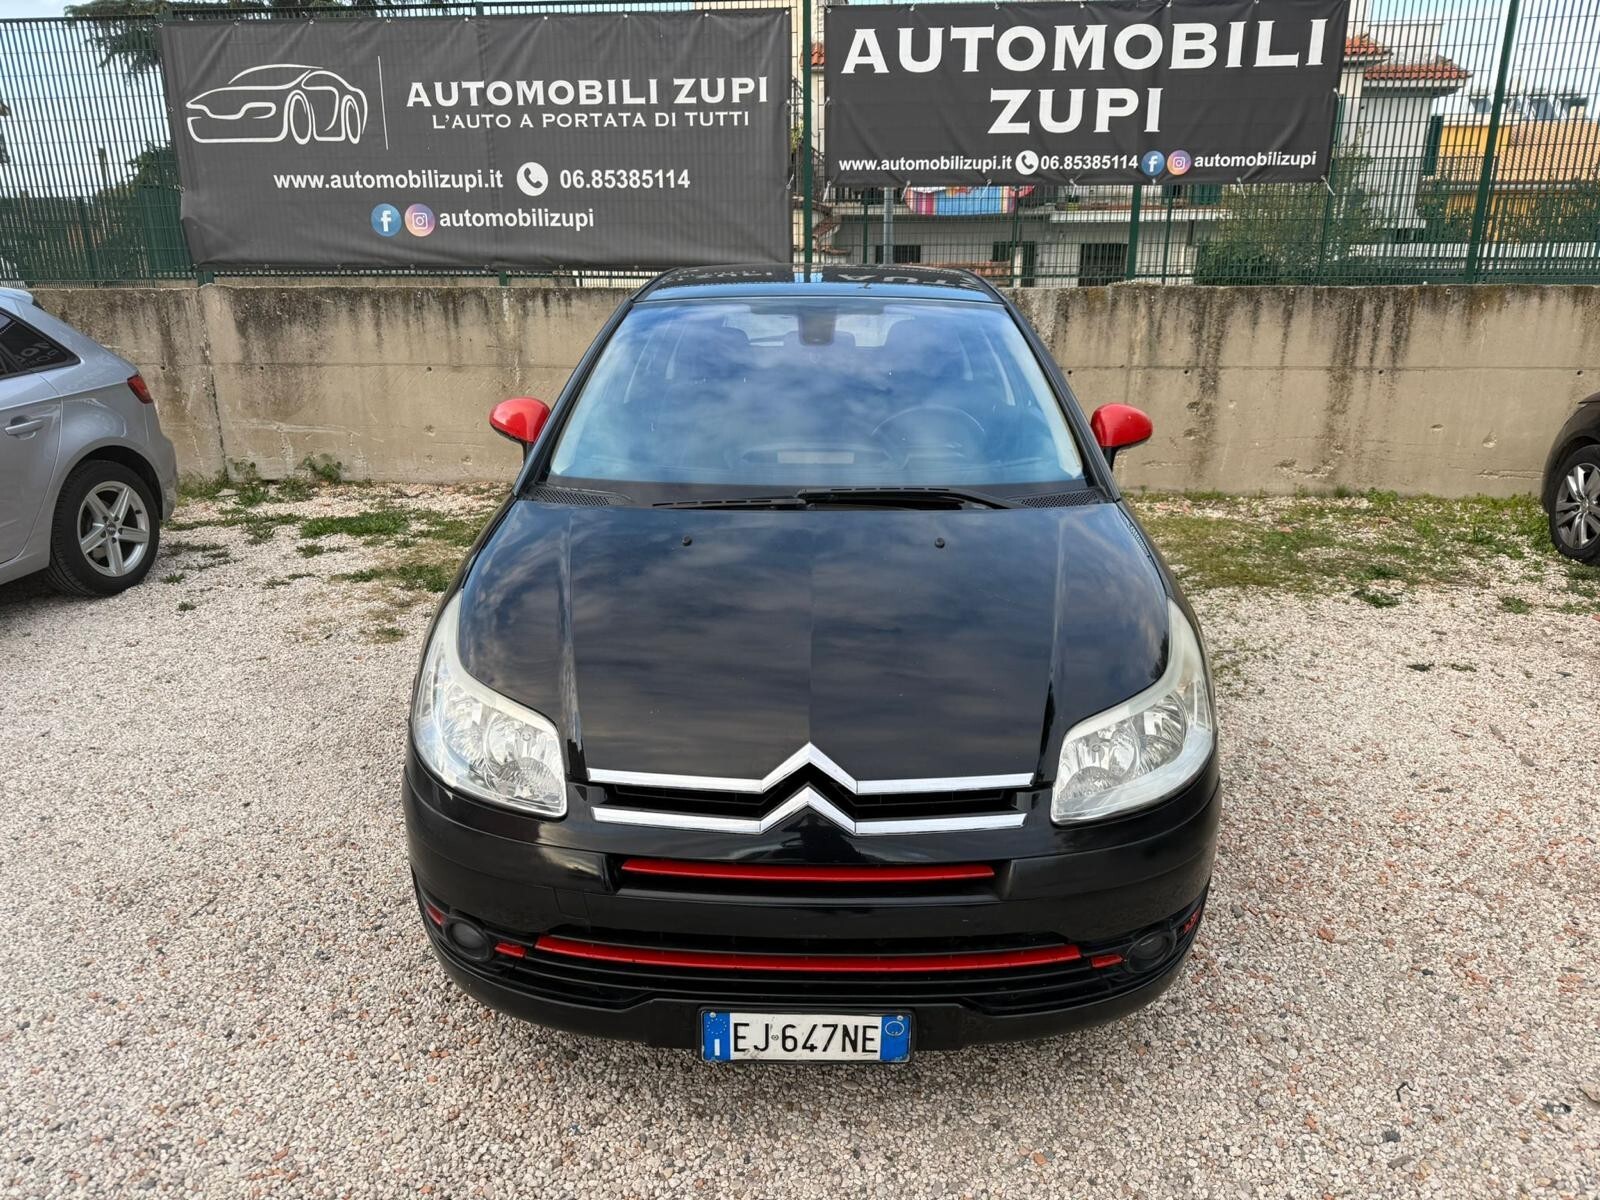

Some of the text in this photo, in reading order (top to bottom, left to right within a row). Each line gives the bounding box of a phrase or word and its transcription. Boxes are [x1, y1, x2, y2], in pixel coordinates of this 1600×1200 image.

[840, 17, 1330, 75] AUTOMOBILI
[406, 75, 769, 109] AUTOMOBILI ZUPI
[432, 110, 750, 130] L'AUTO A PORTATA DI TUTTI
[986, 87, 1165, 136] ZUPI
[838, 153, 1140, 174] www.automobilizupi.it 06.85385114
[1193, 150, 1318, 170] automobilizupi
[272, 167, 692, 193] www.automobilizupi.it 06.85385114
[438, 206, 595, 232] automobilizupi
